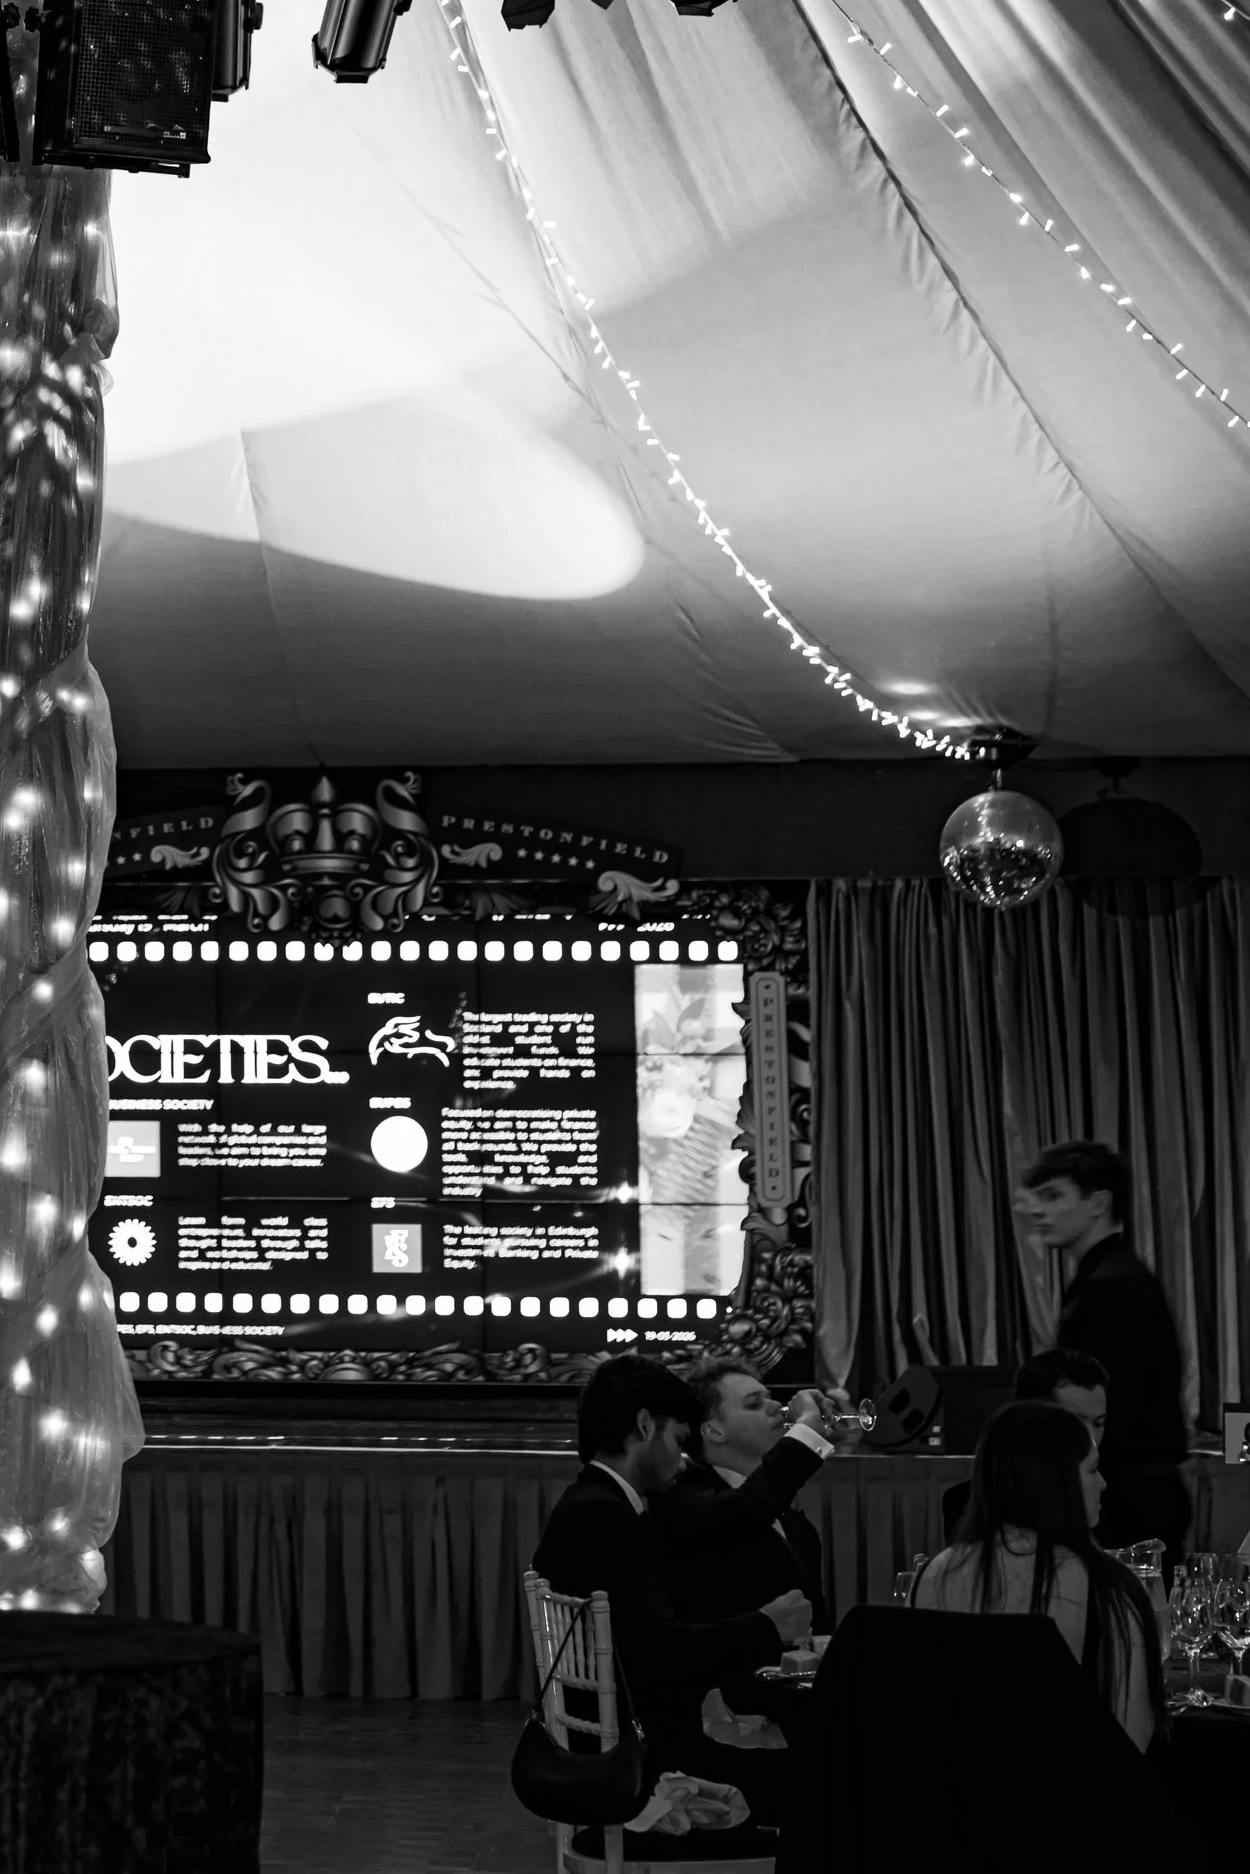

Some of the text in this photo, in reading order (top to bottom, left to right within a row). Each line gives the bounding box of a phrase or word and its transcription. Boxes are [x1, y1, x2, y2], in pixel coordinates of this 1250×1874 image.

[442, 814, 669, 864] PRESTONFIELD
[163, 1099, 214, 1110] SOCIETY
[763, 997, 779, 1179] PRESTONFIELD
